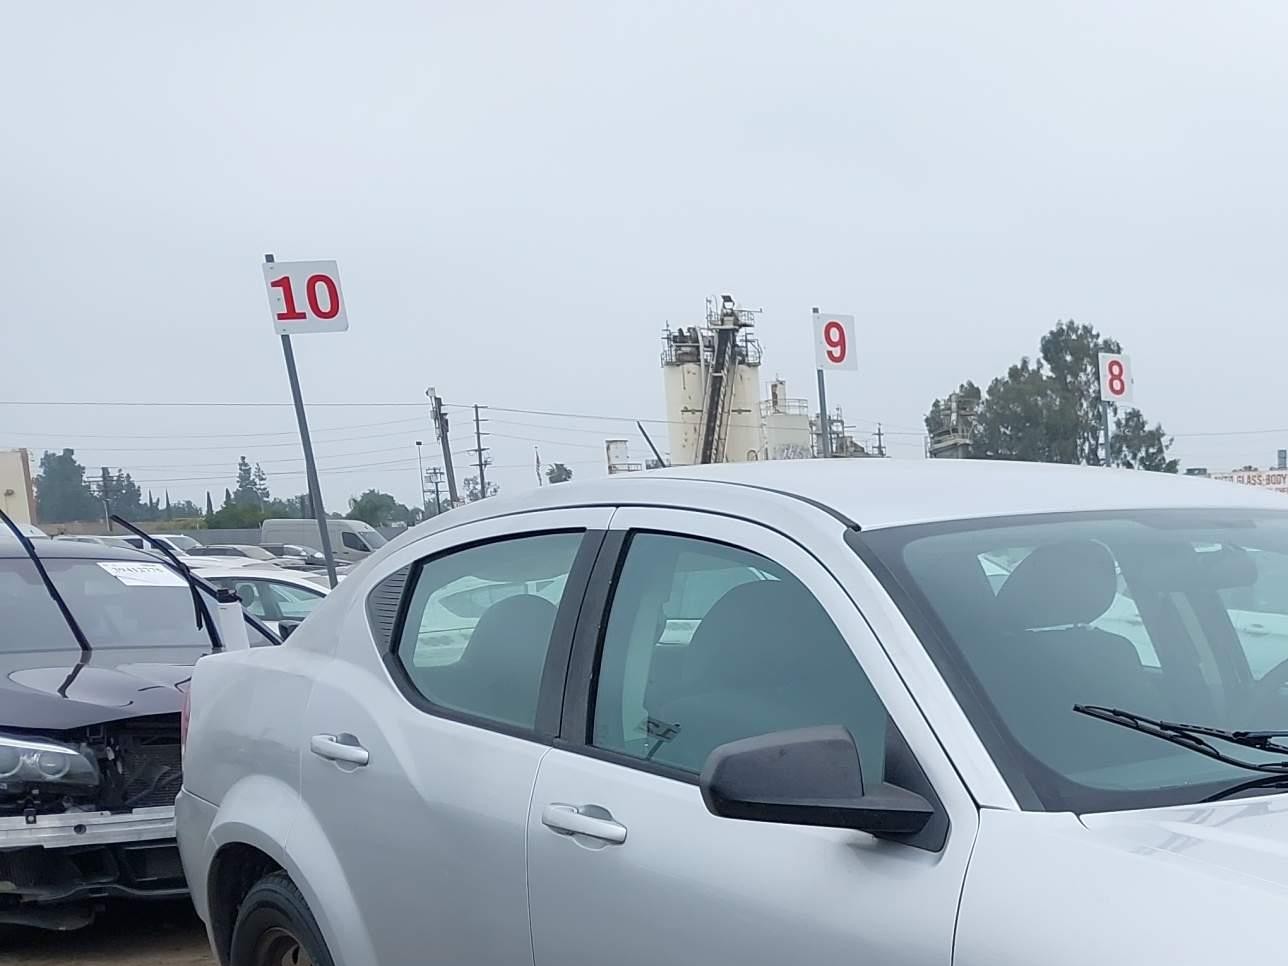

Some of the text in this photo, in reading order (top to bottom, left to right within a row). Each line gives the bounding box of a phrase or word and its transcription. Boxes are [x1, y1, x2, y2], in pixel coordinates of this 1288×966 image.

[272, 274, 341, 321] 10
[823, 320, 847, 364] 9
[1108, 360, 1125, 395] 8
